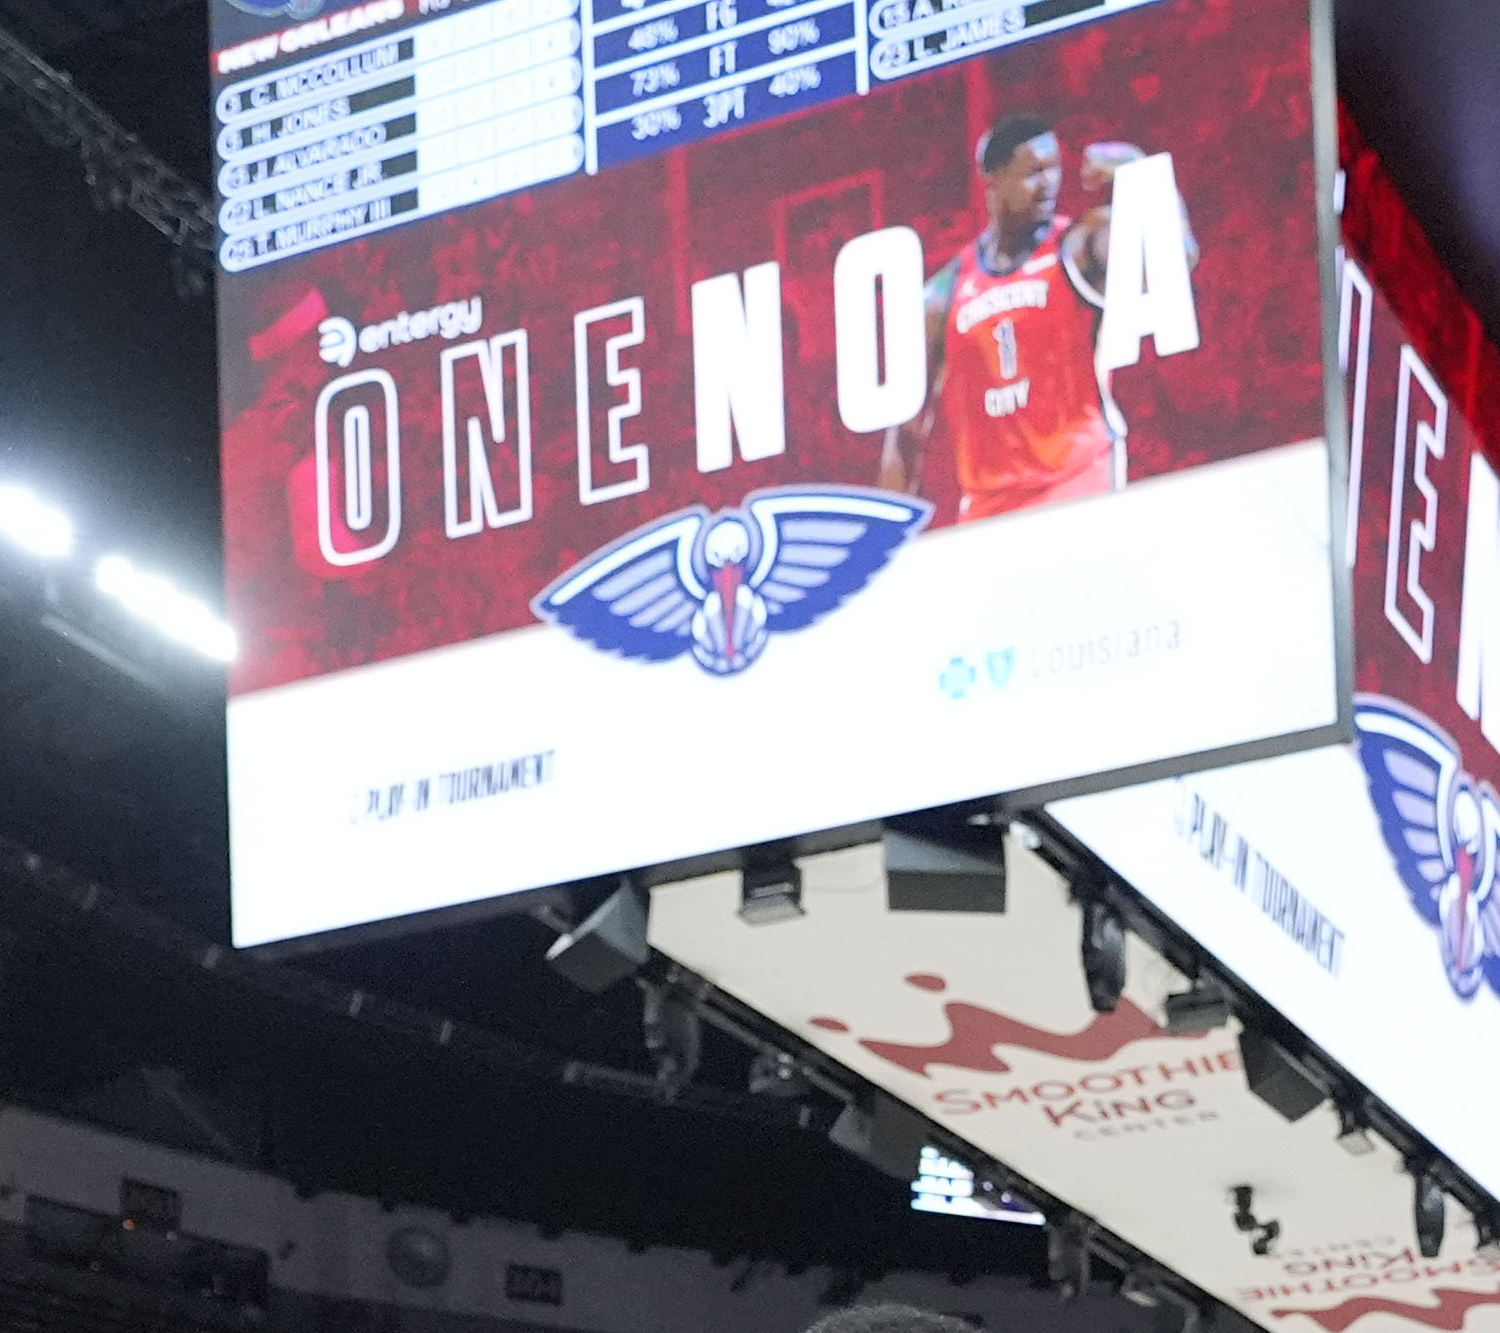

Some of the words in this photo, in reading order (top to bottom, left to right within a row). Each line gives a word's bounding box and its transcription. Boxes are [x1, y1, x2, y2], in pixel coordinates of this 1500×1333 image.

[357, 294, 484, 360] entergy
[992, 316, 1018, 381] 1
[1030, 619, 1182, 680] Louisiana
[933, 1050, 1244, 1116] SMOOTHIE
[1043, 1088, 1197, 1128] KING
